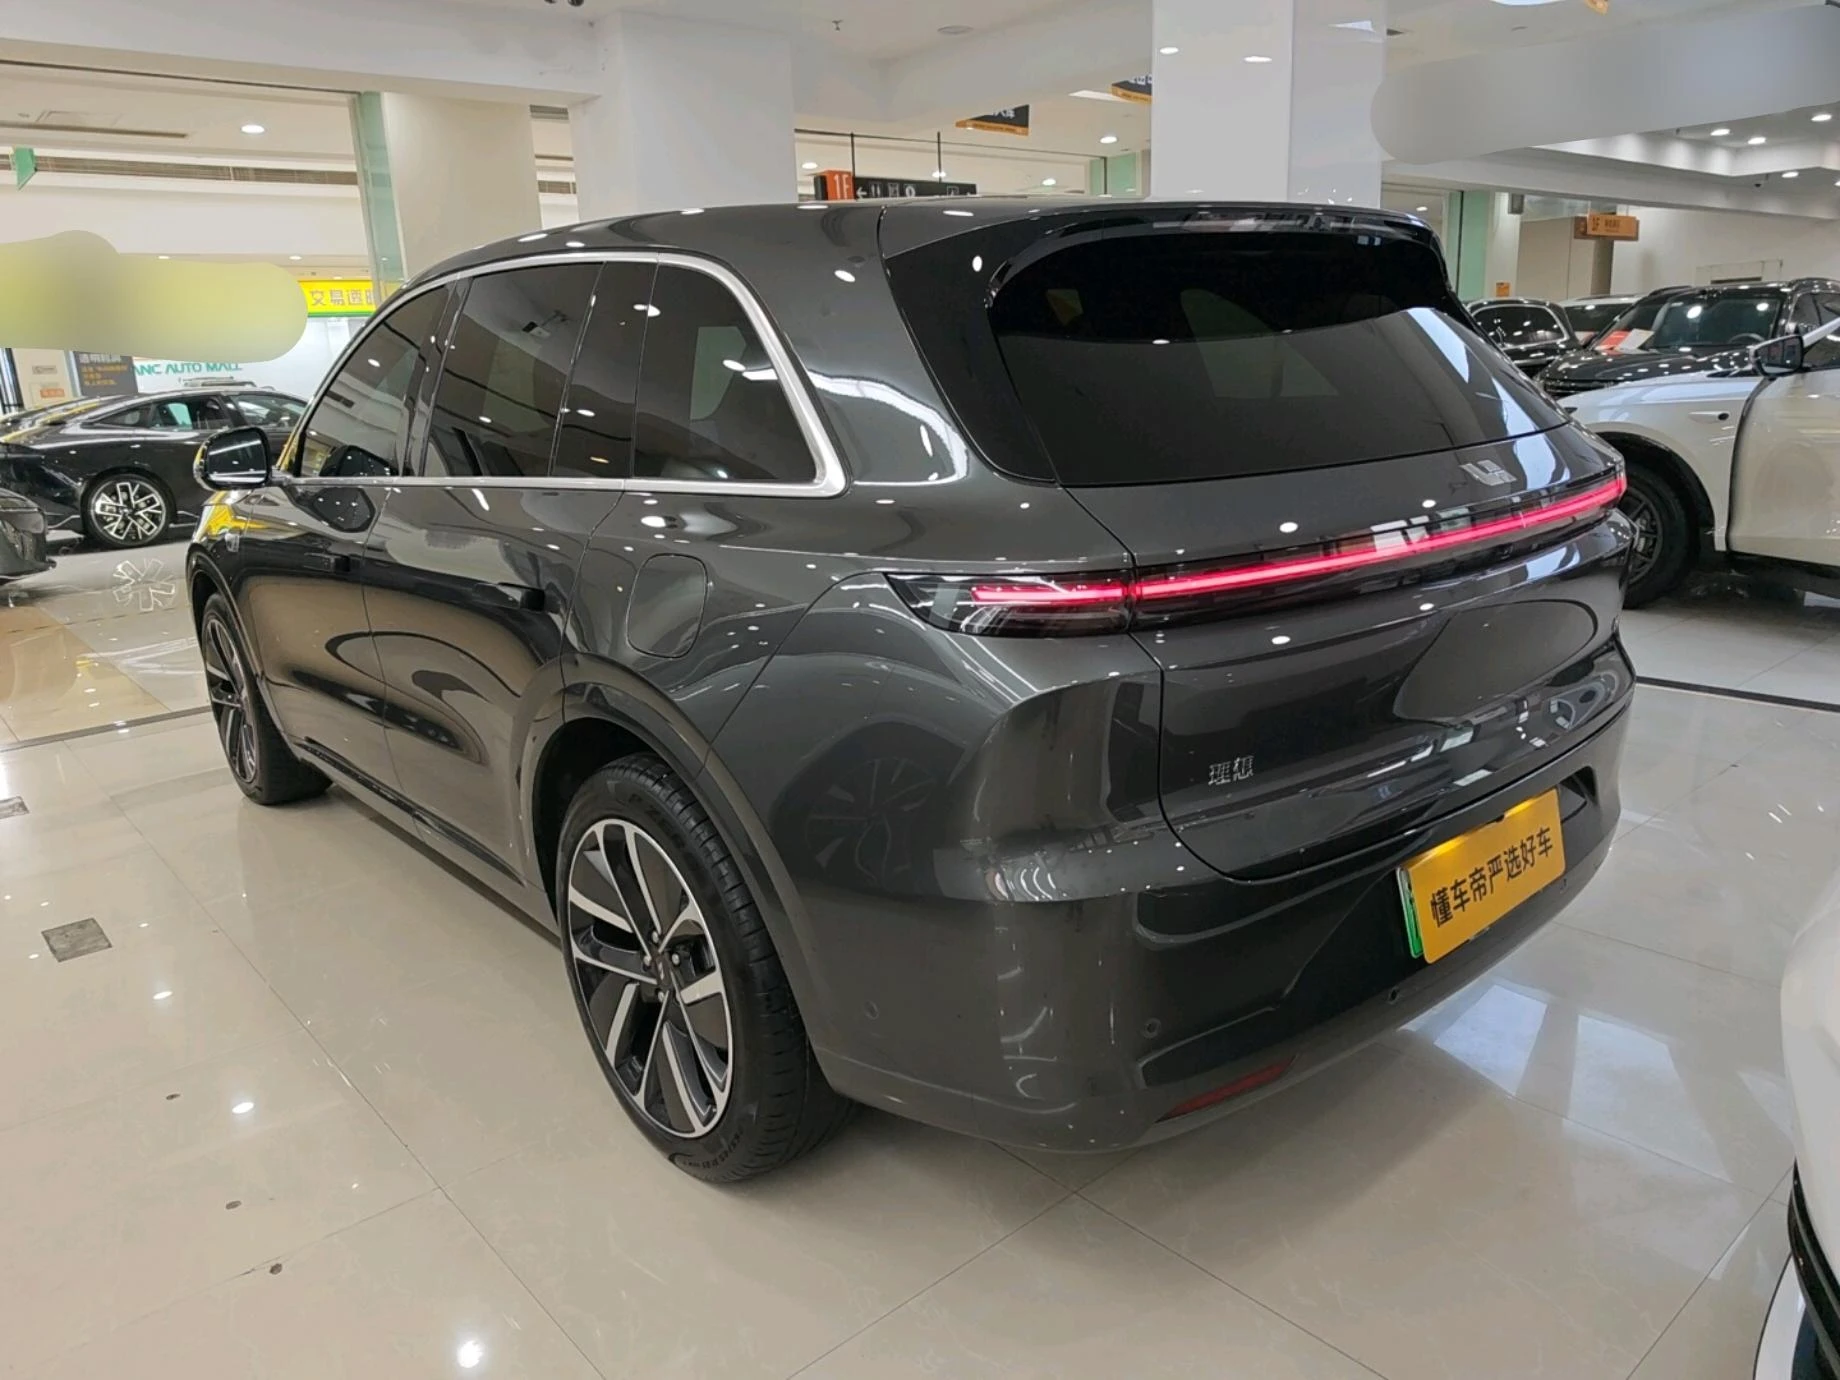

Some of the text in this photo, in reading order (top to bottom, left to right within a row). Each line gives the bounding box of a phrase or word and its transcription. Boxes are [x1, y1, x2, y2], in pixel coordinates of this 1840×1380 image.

[834, 173, 852, 200] 1F
[165, 362, 202, 375] AUTO
[206, 361, 243, 373] MALL
[1207, 755, 1255, 786] 理想
[1429, 826, 1554, 929] 懂车帝严选好车
